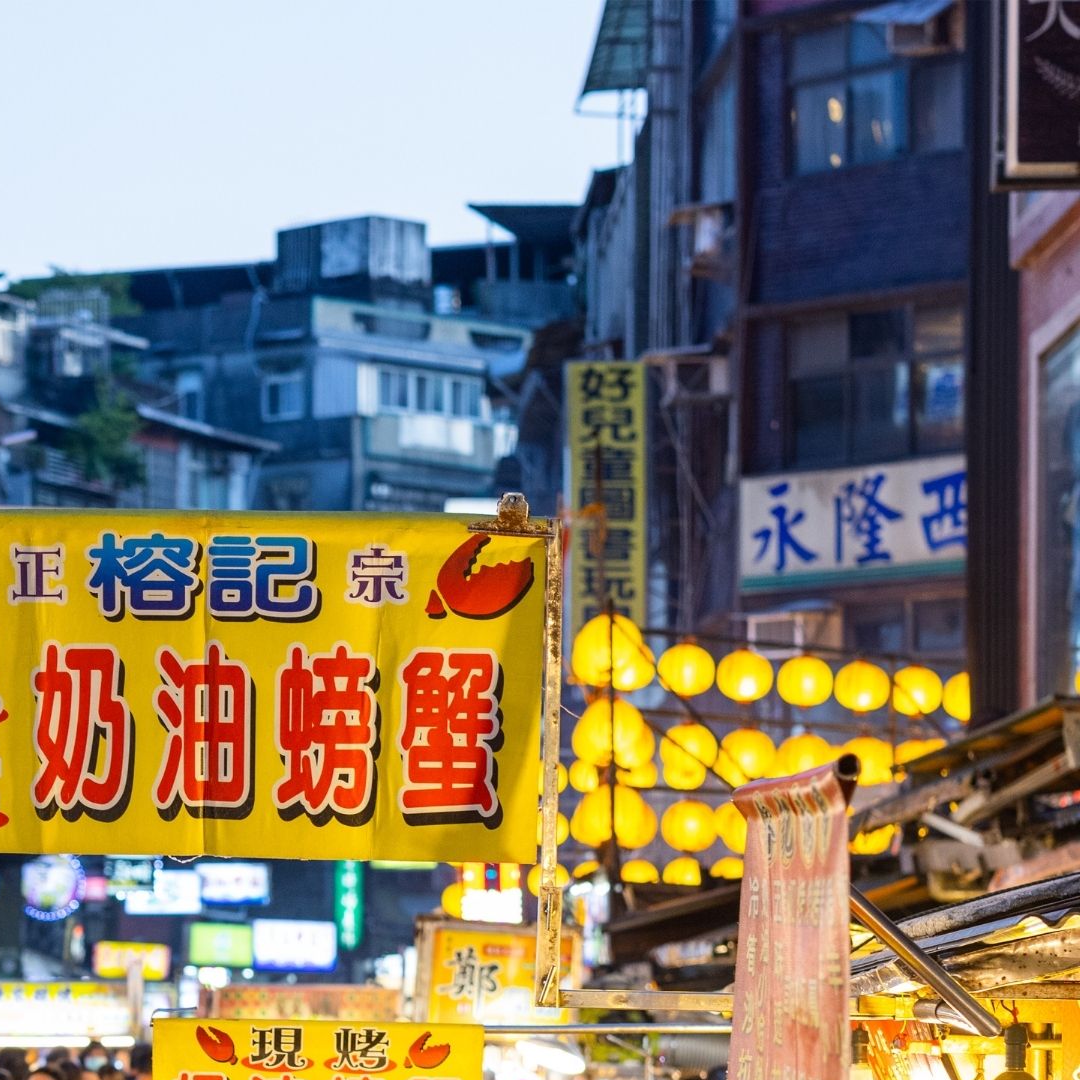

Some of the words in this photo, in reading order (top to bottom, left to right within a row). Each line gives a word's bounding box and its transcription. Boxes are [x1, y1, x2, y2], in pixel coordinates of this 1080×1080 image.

[753, 470, 967, 578] 永隆西
[13, 546, 65, 601] 正
[88, 532, 317, 620] 榕記
[350, 546, 404, 603] 宗
[32, 642, 504, 826] 奶油螃蟹
[251, 1027, 390, 1068] 現烤
